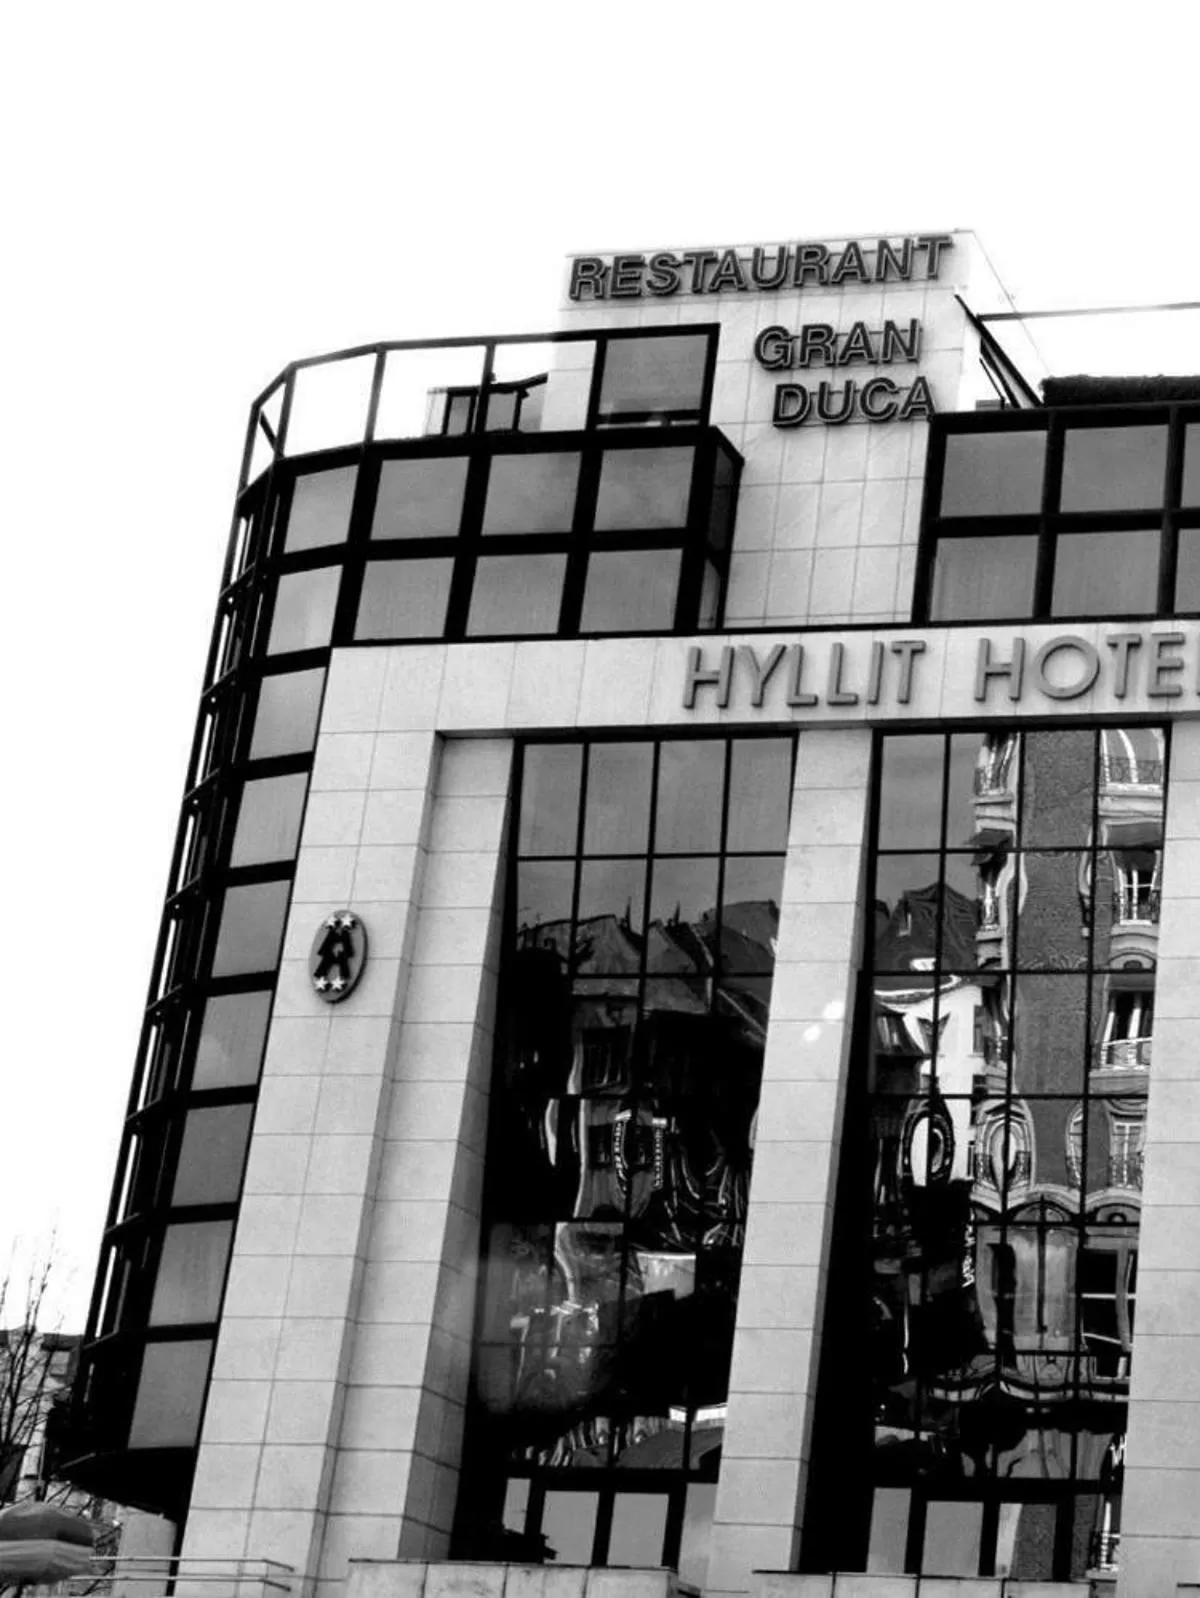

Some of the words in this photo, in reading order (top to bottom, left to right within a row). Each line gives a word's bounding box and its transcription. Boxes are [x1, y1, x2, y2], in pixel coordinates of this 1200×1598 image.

[569, 235, 953, 300] RESTAURANT
[754, 318, 921, 371] GRAN
[772, 376, 936, 428] DUCA
[683, 640, 926, 709] HYLLIT
